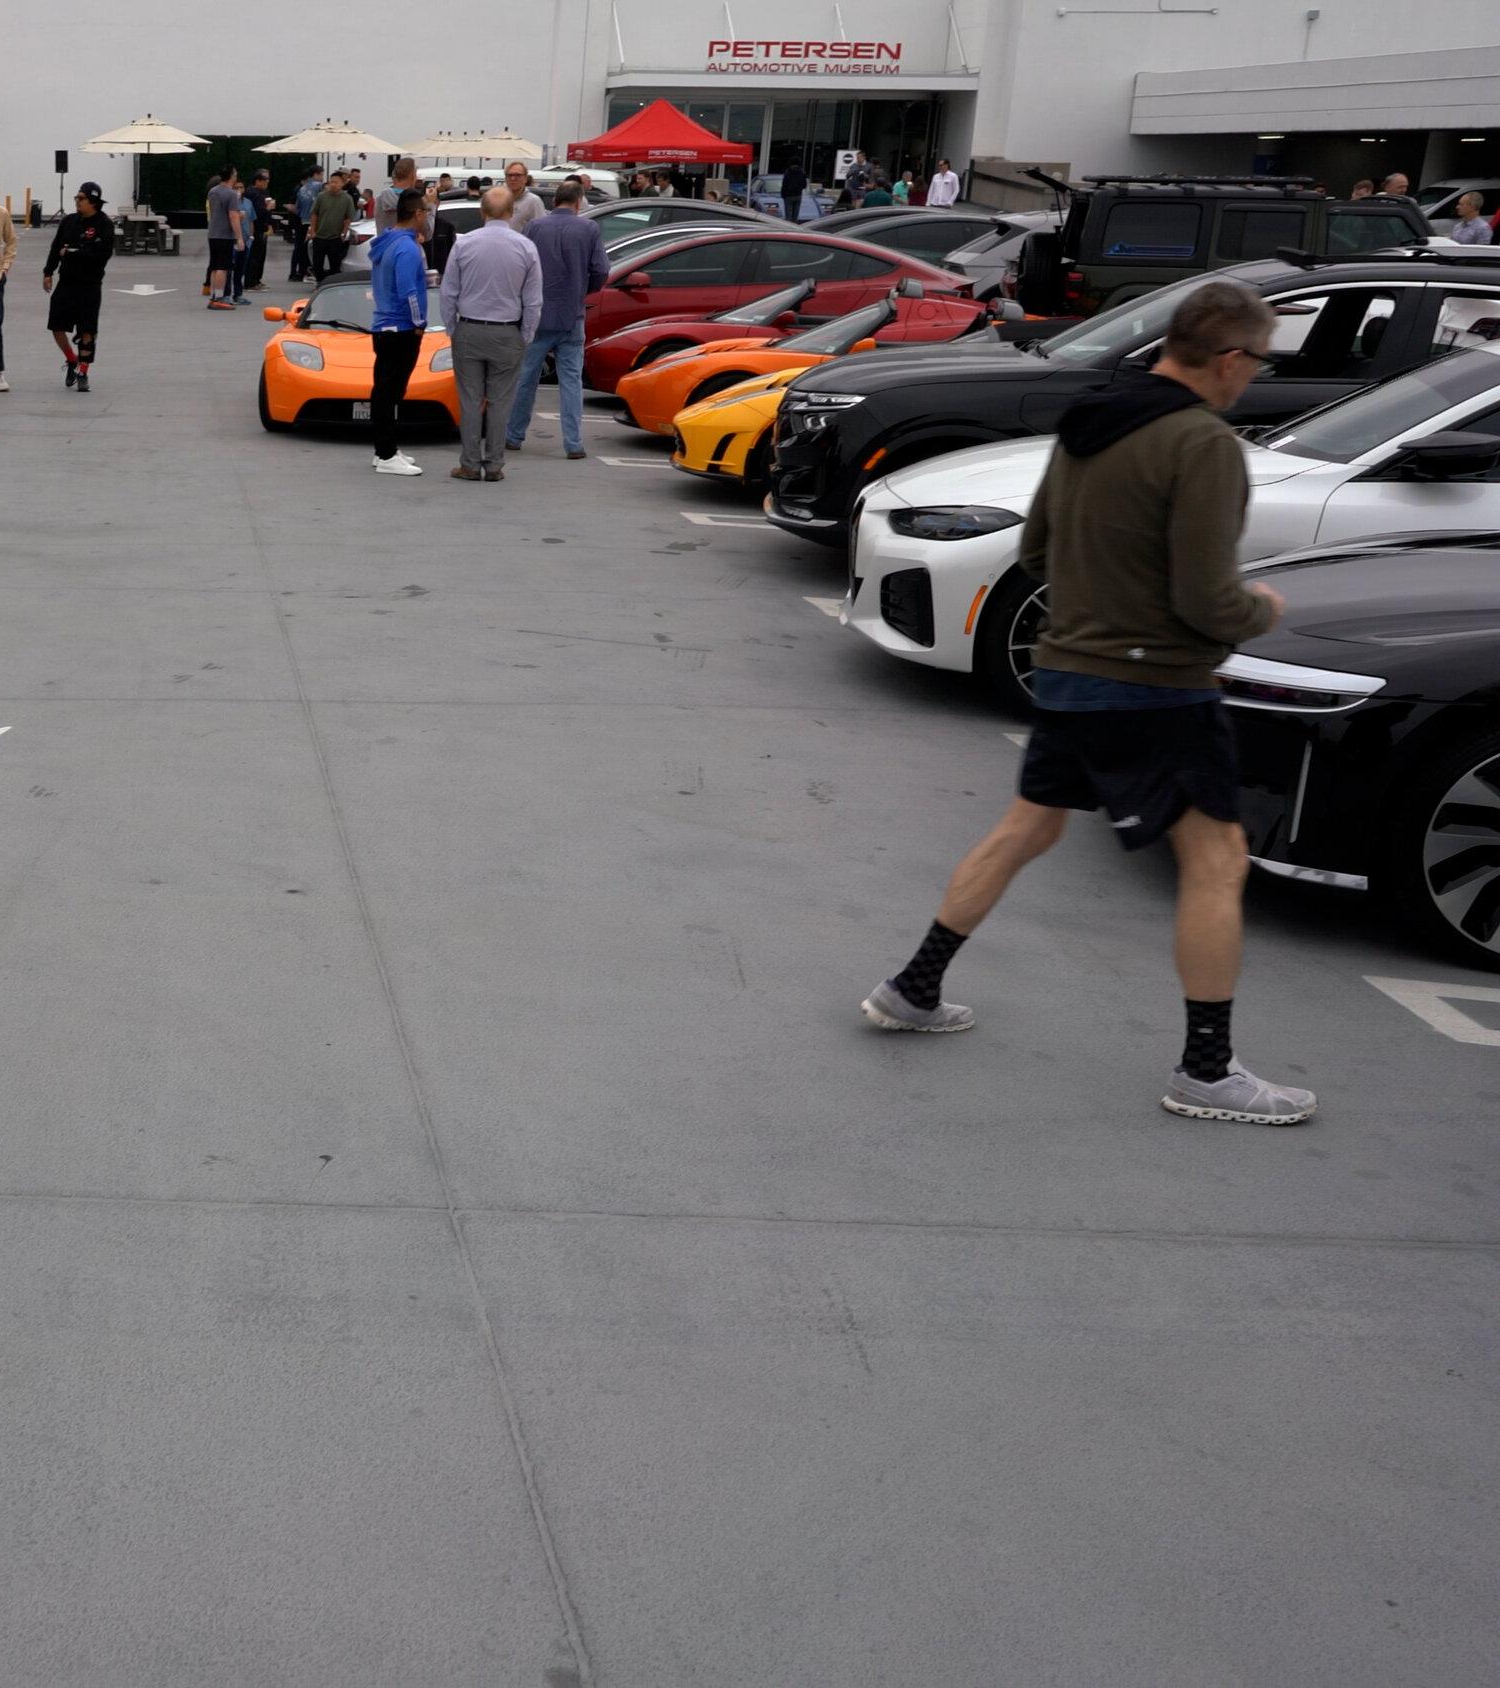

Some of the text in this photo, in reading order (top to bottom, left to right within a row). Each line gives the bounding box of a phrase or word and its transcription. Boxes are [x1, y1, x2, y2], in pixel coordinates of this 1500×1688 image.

[708, 41, 902, 60] PETERSEN
[707, 62, 900, 75] AUTOMOTIVE MUSEUM
